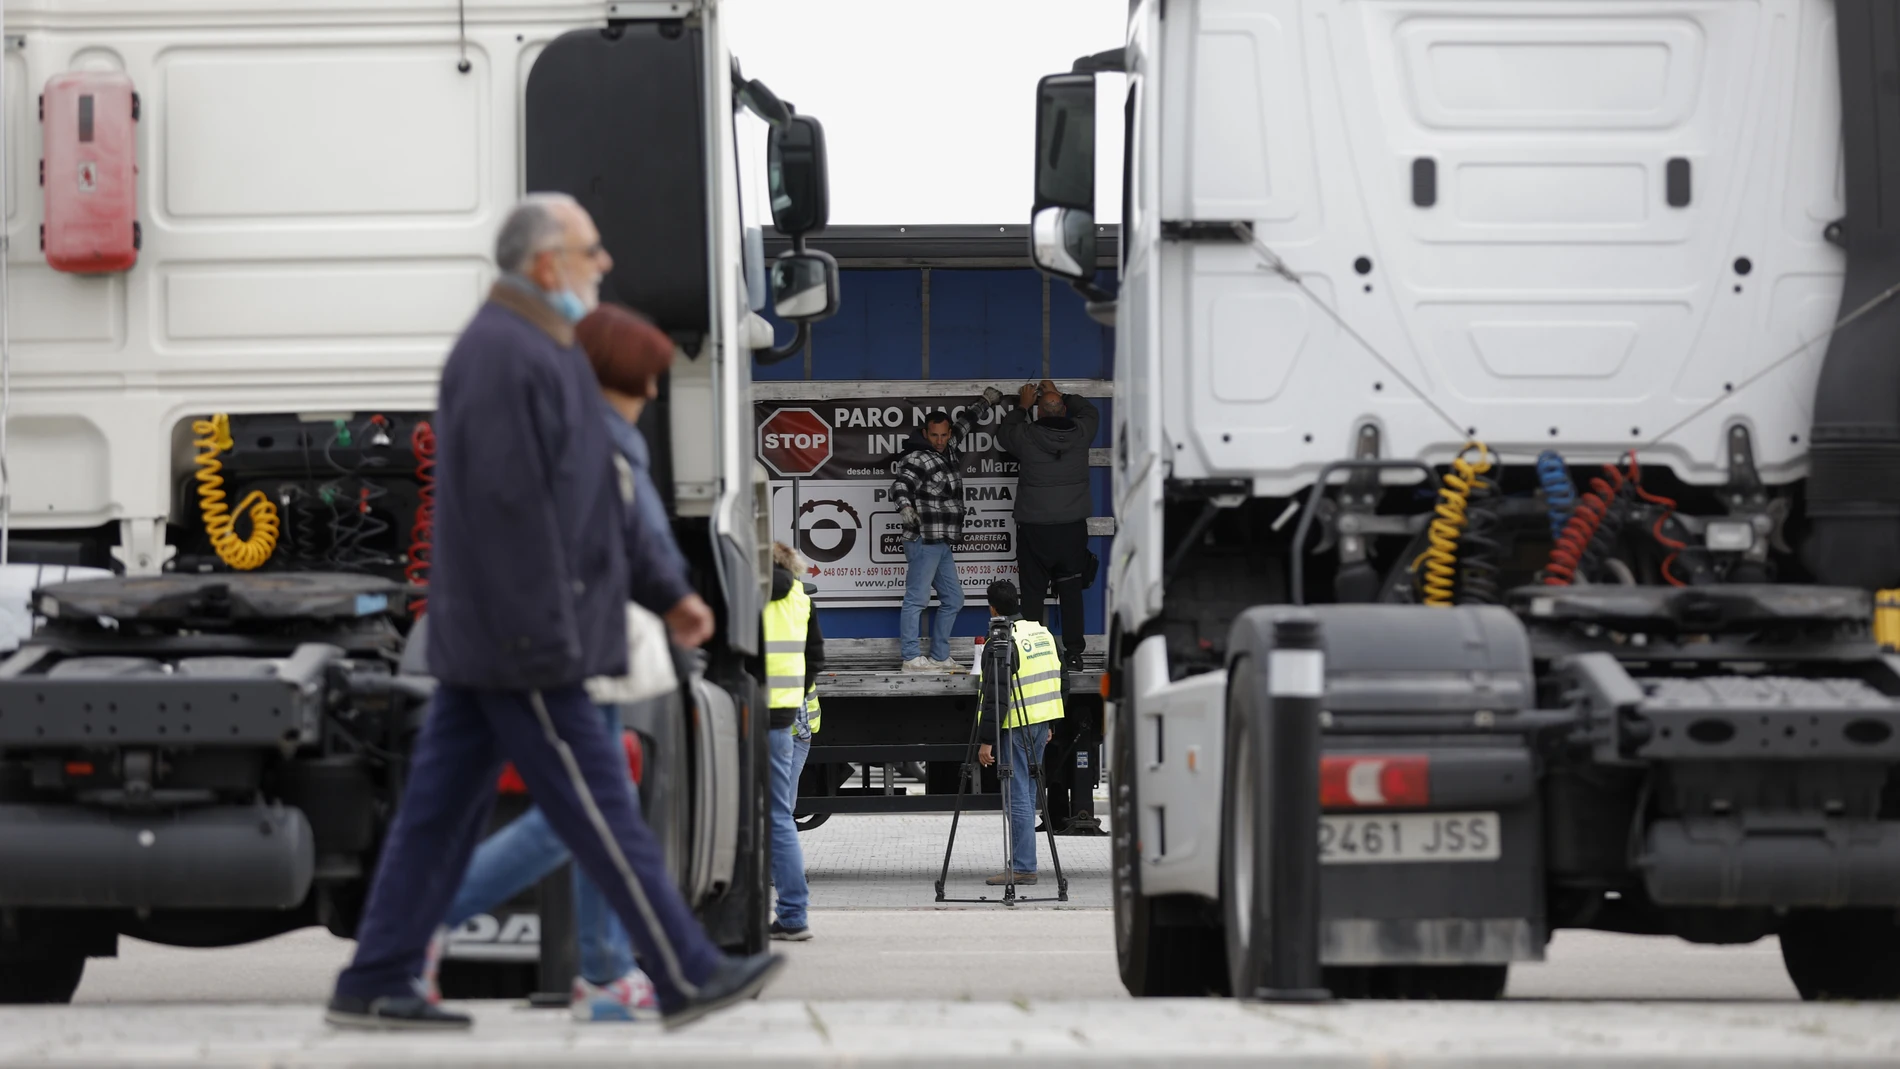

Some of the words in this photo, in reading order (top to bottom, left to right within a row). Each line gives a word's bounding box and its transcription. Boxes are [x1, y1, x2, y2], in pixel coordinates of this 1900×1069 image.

[835, 406, 904, 428] PARO
[764, 433, 826, 449] STOP
[846, 467, 871, 475] desde
[872, 467, 885, 475] las
[966, 465, 977, 473] de
[824, 567, 835, 576] 648
[837, 567, 849, 576] 057
[850, 567, 862, 576] 615
[866, 566, 879, 576] 659
[880, 566, 892, 576] 165
[893, 566, 905, 576] 710
[966, 565, 978, 574] 990
[979, 565, 991, 574] 528
[996, 565, 1008, 573] 637
[1318, 820, 1402, 857] 2461
[1422, 818, 1489, 854] JSS
